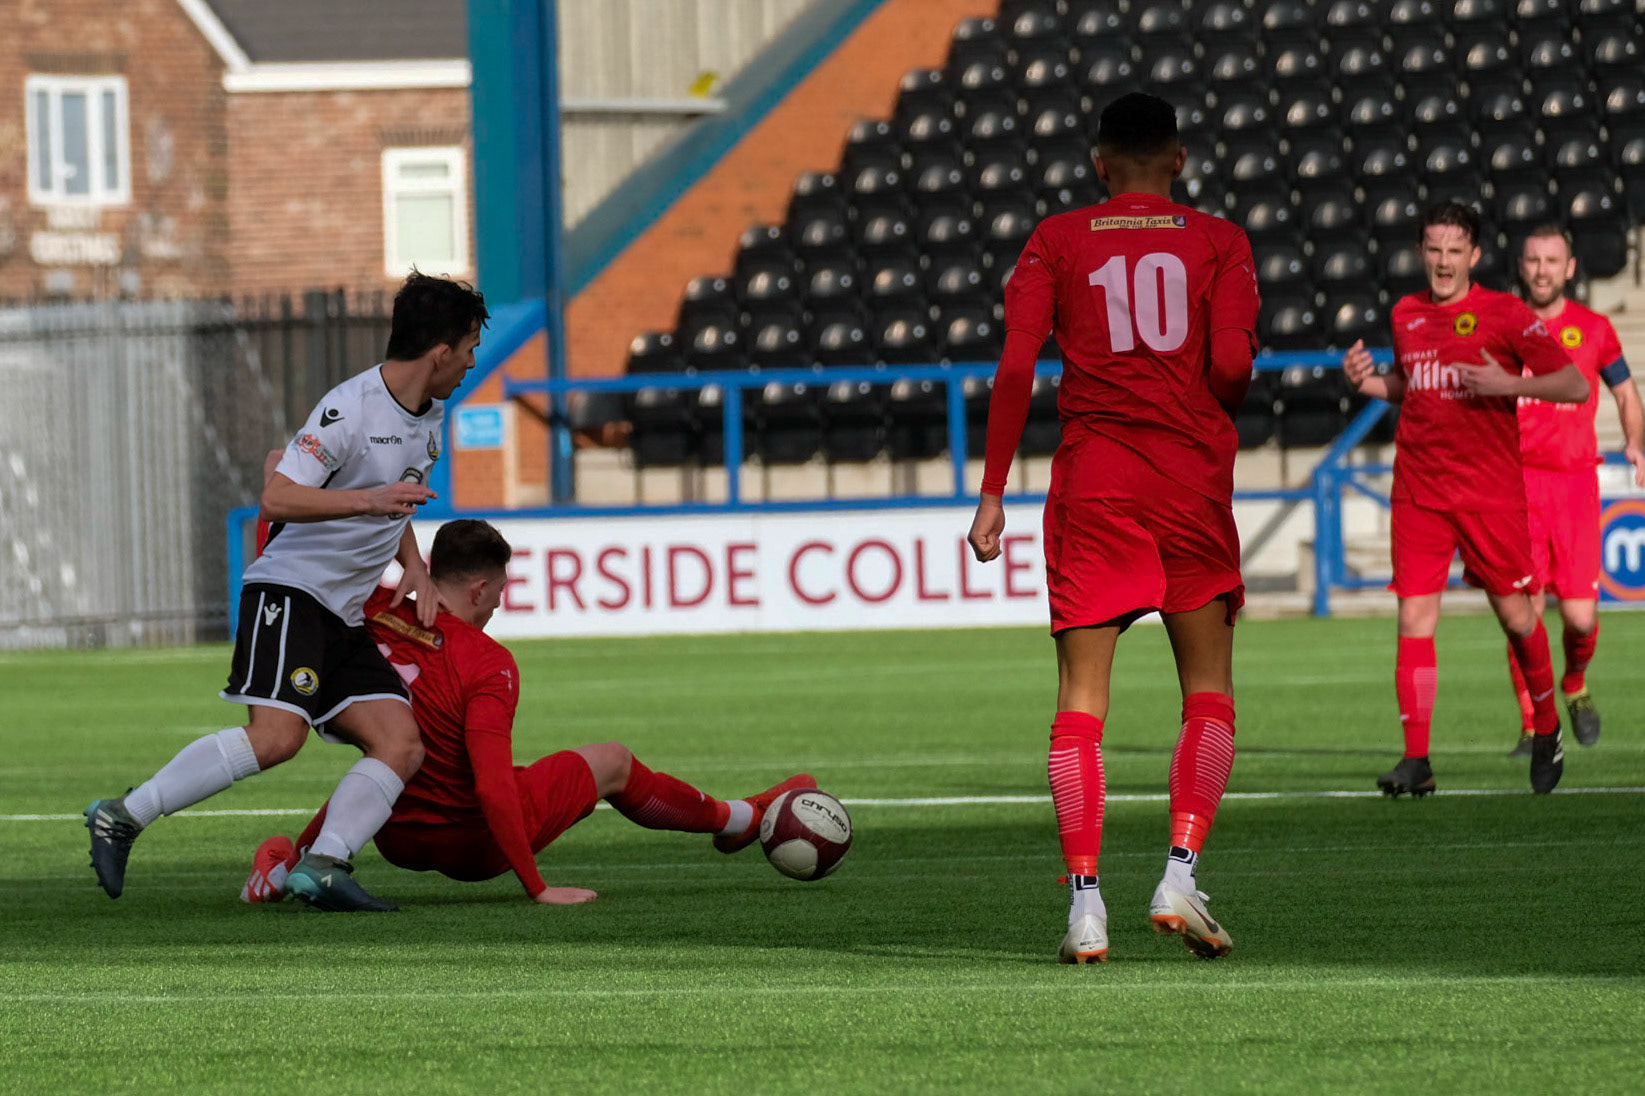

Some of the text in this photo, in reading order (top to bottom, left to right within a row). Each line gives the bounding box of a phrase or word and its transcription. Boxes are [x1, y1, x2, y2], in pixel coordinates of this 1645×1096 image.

[1094, 216, 1171, 228] Britannia Taxis
[1088, 252, 1188, 353] 10
[1403, 360, 1460, 391] Miln
[369, 435, 403, 445] macron
[503, 534, 1040, 612] ERSIDE COLLE
